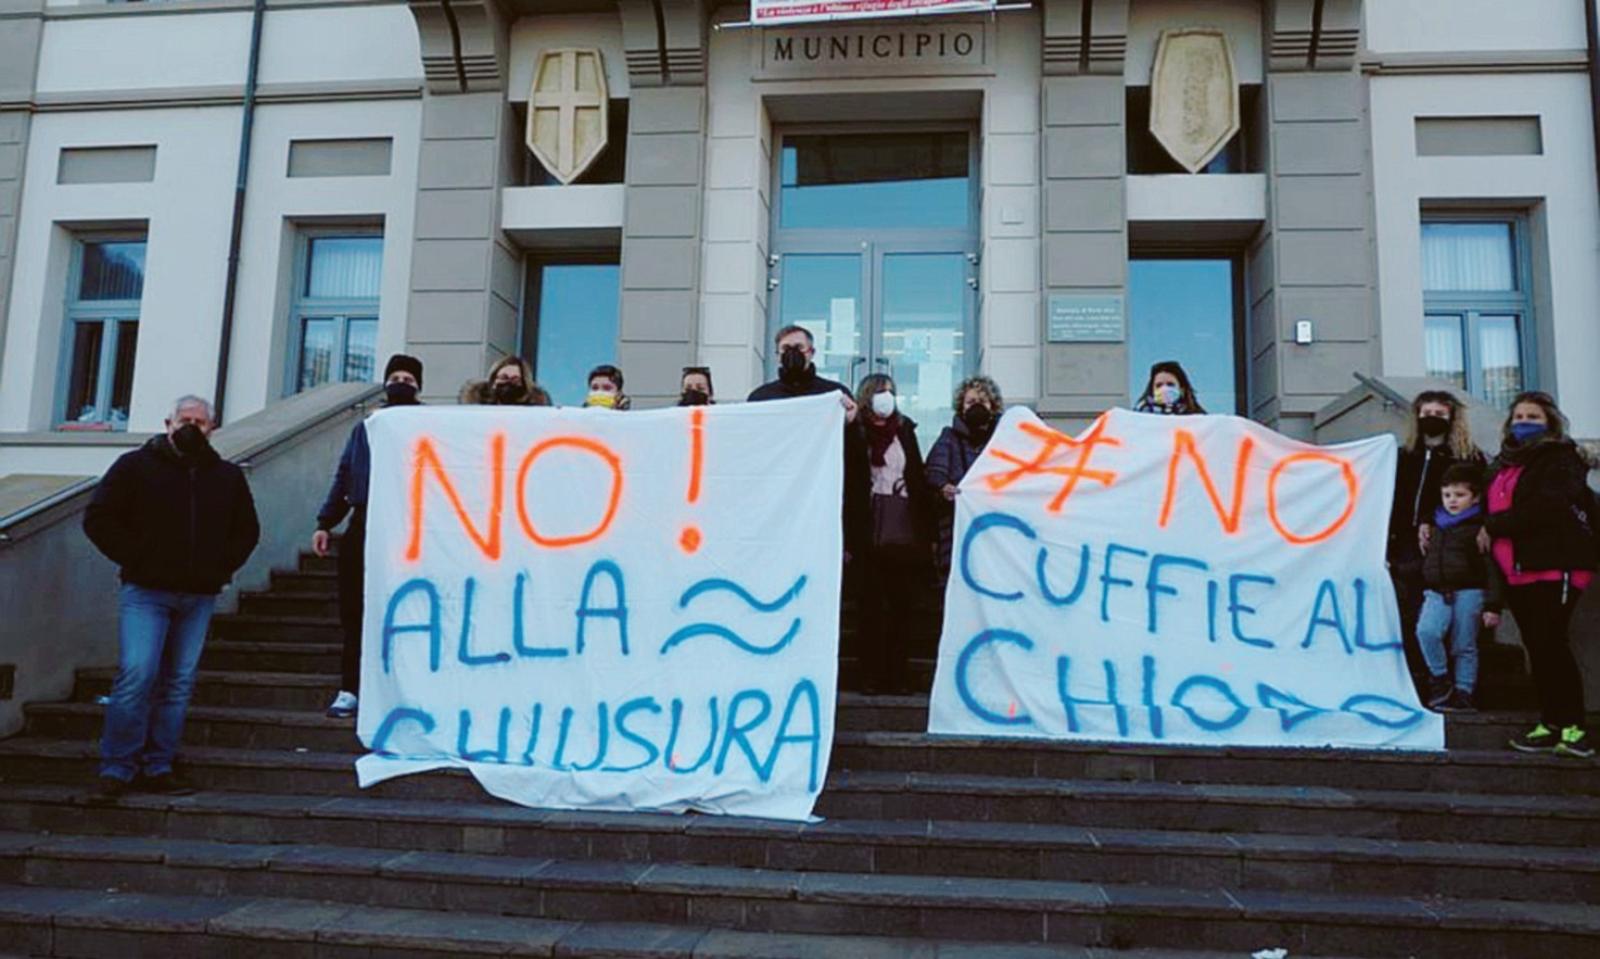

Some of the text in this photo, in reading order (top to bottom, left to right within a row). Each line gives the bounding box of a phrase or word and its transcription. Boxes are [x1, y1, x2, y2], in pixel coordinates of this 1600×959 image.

[774, 32, 973, 61] MUNICIPIO
[405, 434, 622, 561] NO
[1158, 429, 1357, 543] NO
[382, 559, 629, 674] ALLA
[960, 512, 1401, 655] CUFFIE AL
